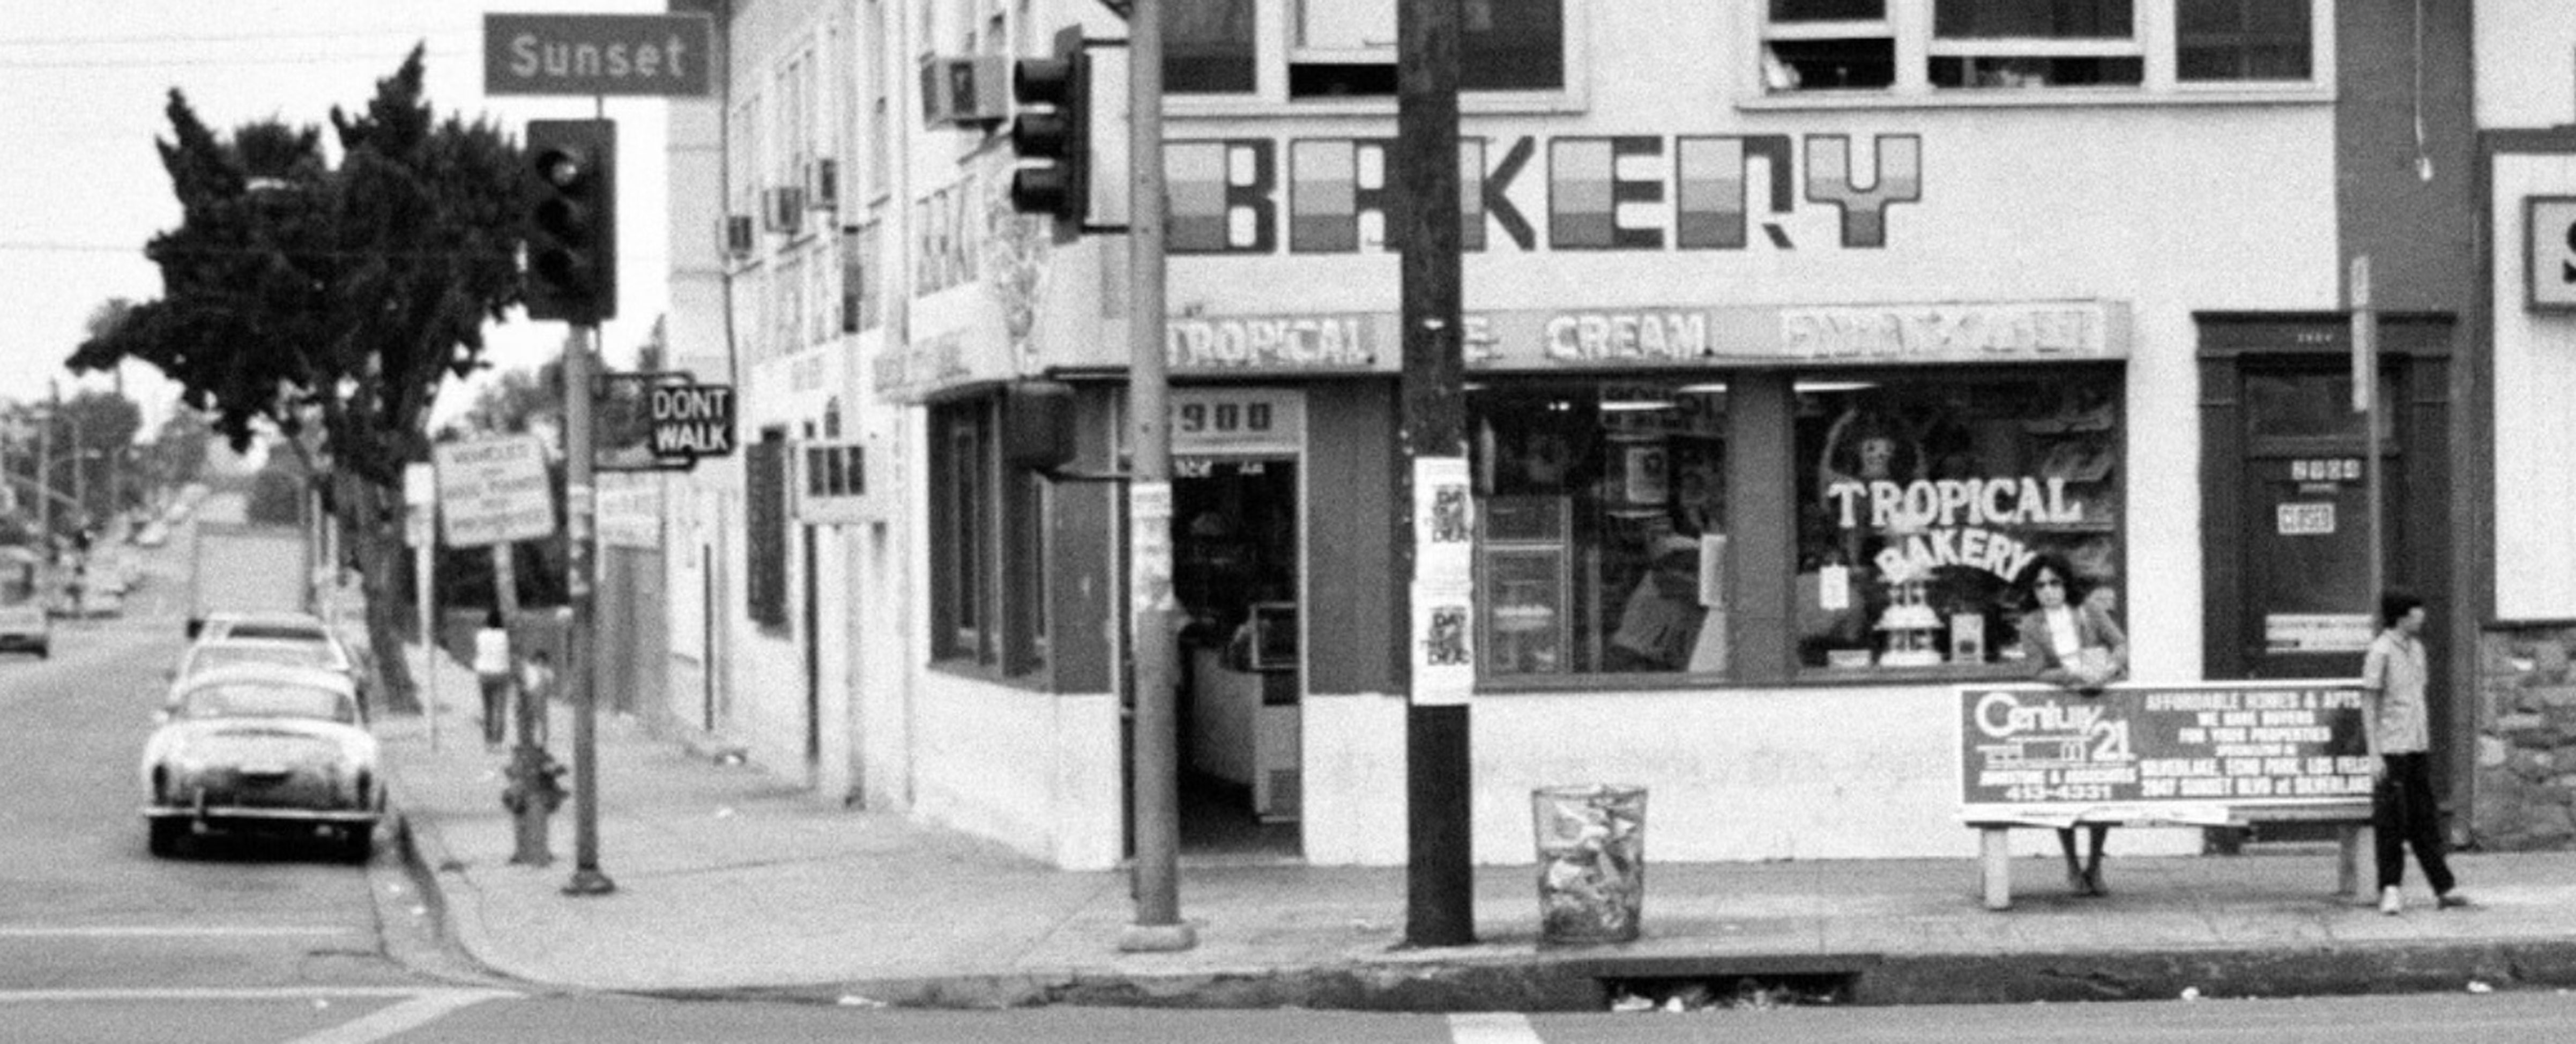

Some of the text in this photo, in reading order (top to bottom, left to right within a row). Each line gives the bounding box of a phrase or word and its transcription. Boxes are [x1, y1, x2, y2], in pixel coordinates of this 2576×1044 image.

[510, 33, 686, 77] Sunset
[1162, 134, 1922, 255] BAKERY
[1168, 320, 1367, 369] TROPICAL
[1547, 314, 1707, 360] CREAM
[653, 389, 728, 419] DONT
[1181, 403, 1272, 431] 900
[657, 424, 728, 451] WALK
[1828, 477, 2083, 528] TROPICAL
[1874, 529, 2037, 584] BAKERY
[2145, 690, 2361, 710] AFFORDABLE HOMES & APTS
[1975, 692, 2138, 761] Century 21
[2197, 710, 2316, 727] WE HAVE BUYERS
[2178, 726, 2332, 744] FOR YOUR PROPERTIES
[2224, 757, 2262, 776] ECHO
[2307, 757, 2333, 774] LOS
[2004, 784, 2113, 801] 413-4331
[2179, 777, 2234, 797] SUNSET
[2236, 776, 2273, 796] BLVD
[2294, 775, 2373, 795] SILVERLAKE
